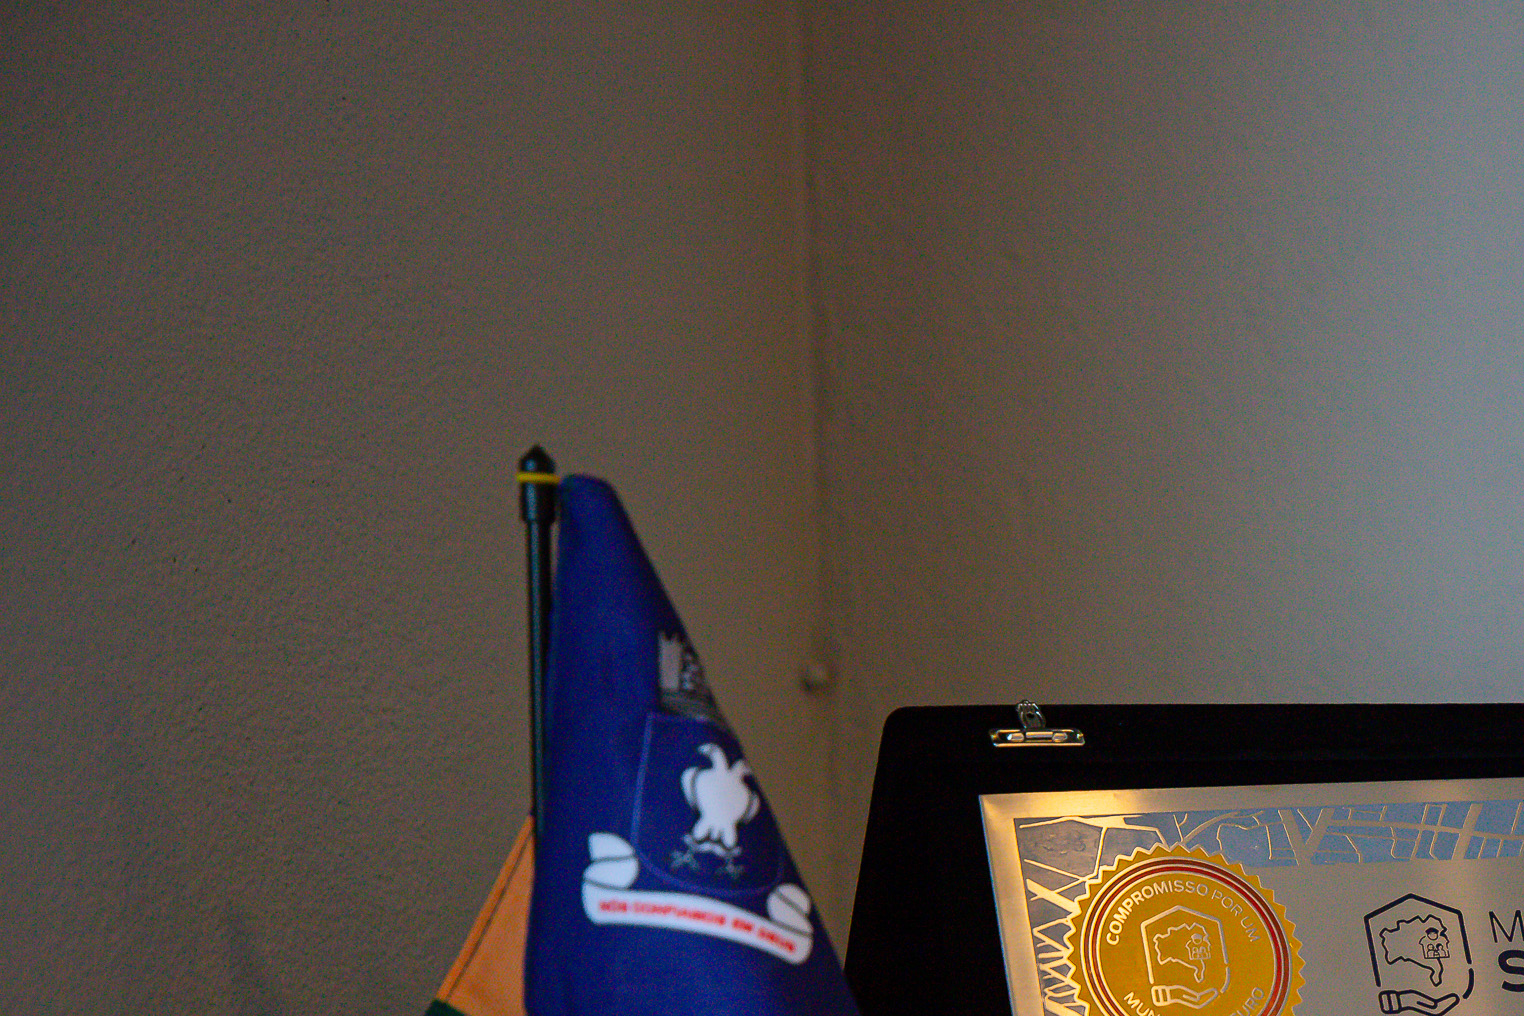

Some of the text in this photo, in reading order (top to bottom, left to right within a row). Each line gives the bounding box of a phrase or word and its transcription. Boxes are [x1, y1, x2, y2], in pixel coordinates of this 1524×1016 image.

[1106, 879, 1261, 946] COMPROMISSO POR UM
